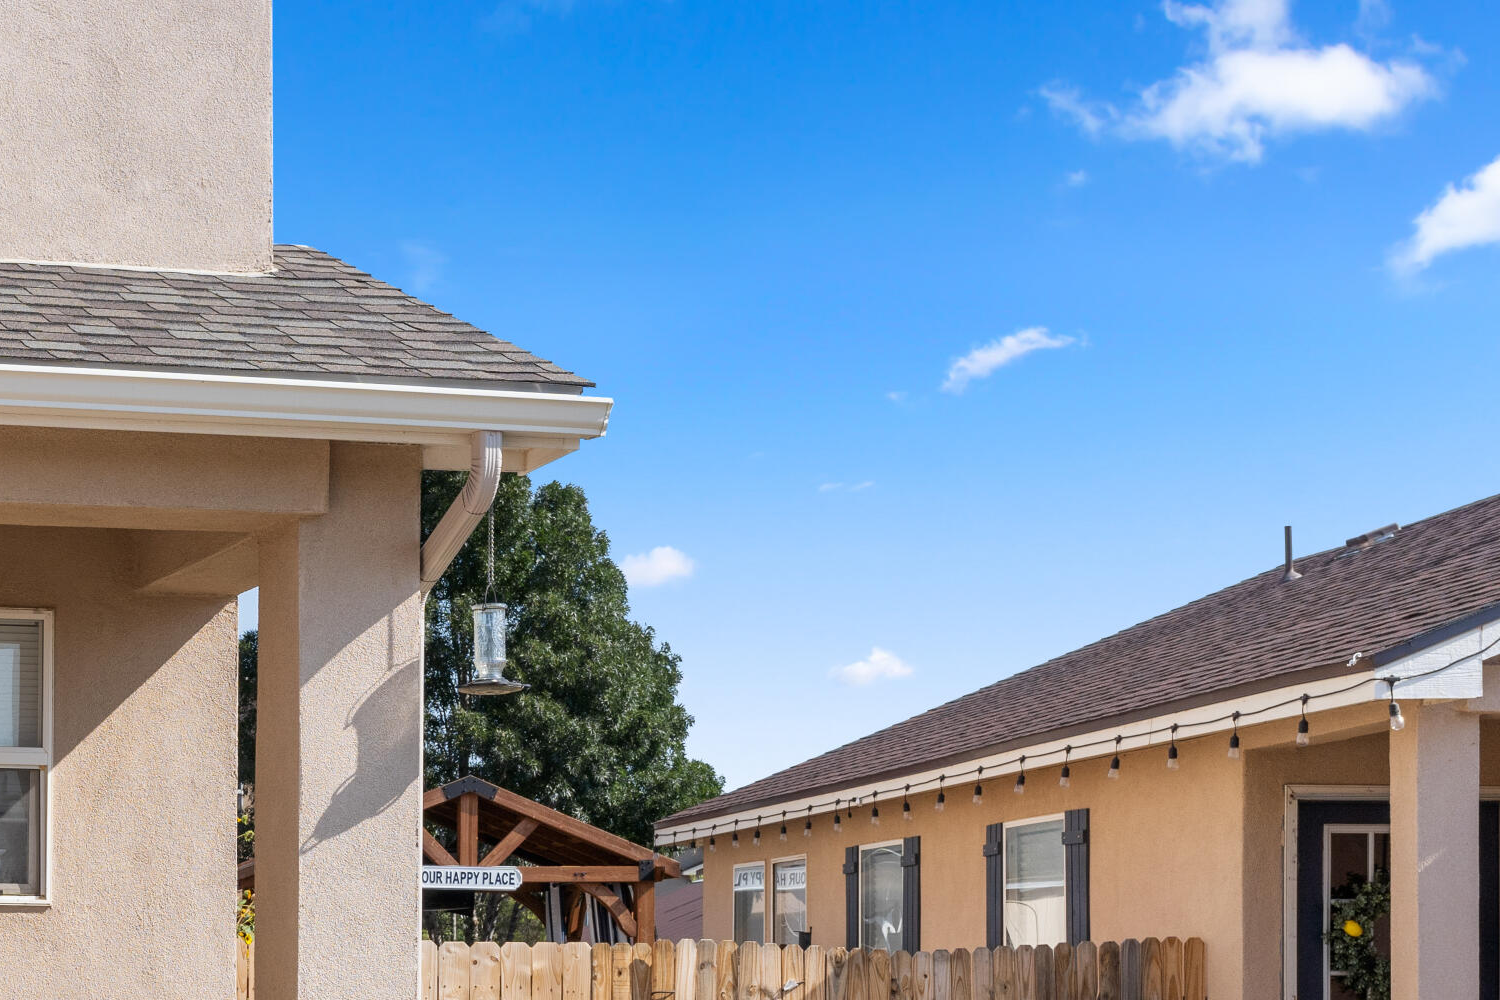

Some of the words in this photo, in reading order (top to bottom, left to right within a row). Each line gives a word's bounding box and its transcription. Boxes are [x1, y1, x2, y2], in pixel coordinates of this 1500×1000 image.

[422, 870, 443, 884] OUR
[445, 871, 480, 885] HAPPY
[482, 872, 515, 886] PLACE
